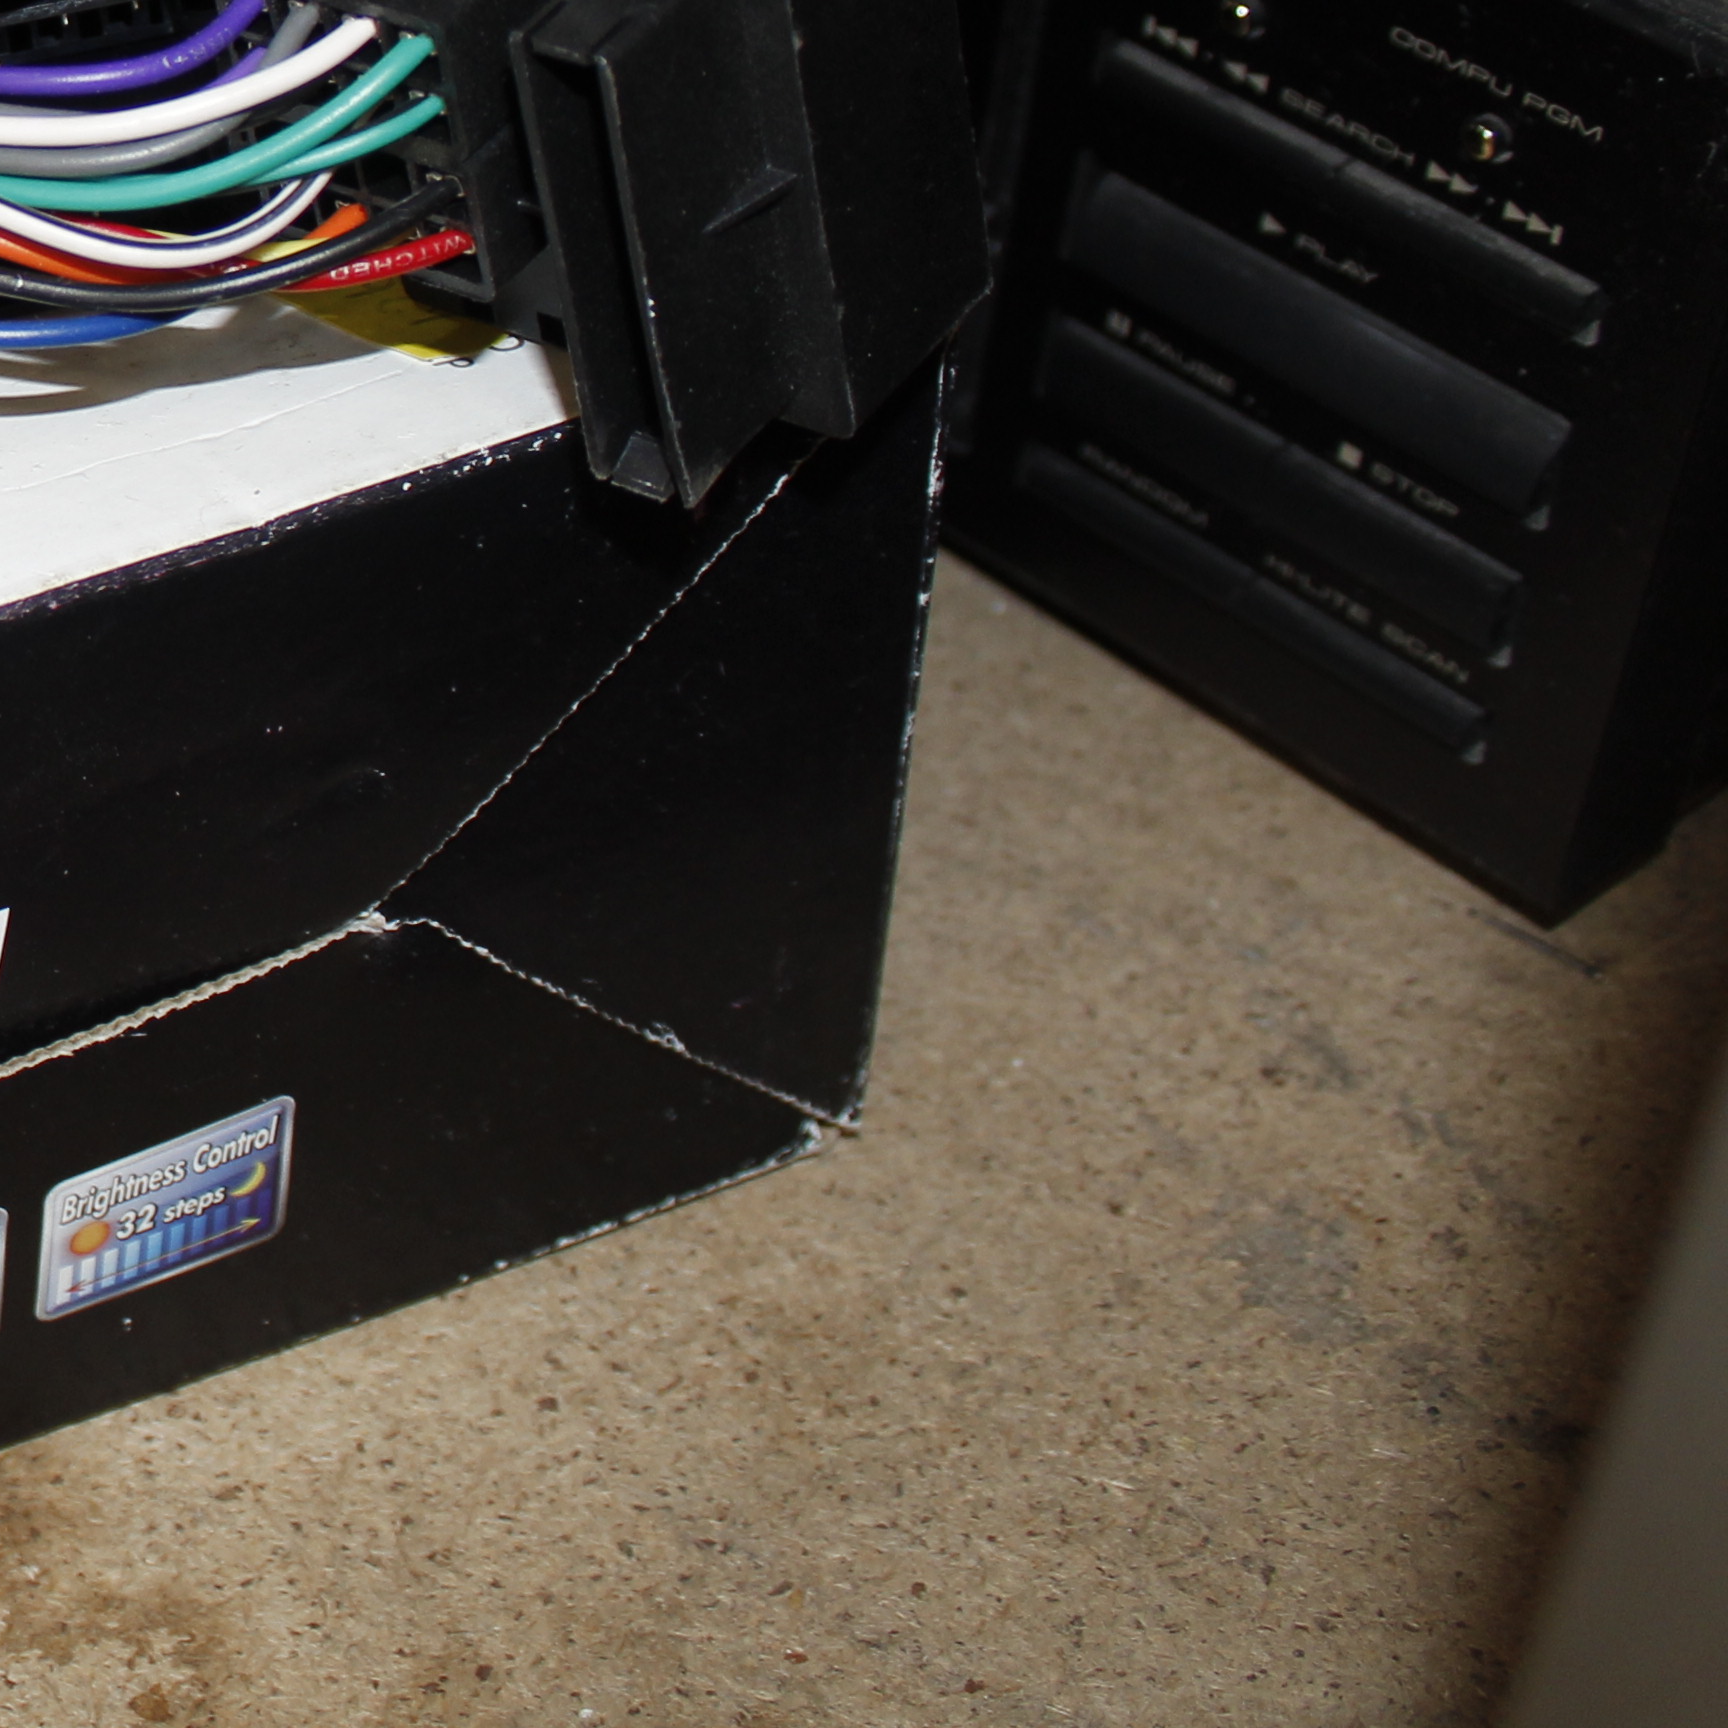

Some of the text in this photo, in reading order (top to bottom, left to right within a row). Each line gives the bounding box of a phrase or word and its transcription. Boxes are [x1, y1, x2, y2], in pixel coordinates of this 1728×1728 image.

[1389, 25, 1604, 142] COMPU PGM
[1279, 87, 1414, 167] SEARCH
[331, 234, 470, 280] WITCHED
[1294, 232, 1380, 284] PLAY
[1369, 461, 1459, 517] STOP
[60, 1114, 280, 1225] Brightness Control
[116, 1186, 226, 1241] 32 steps
